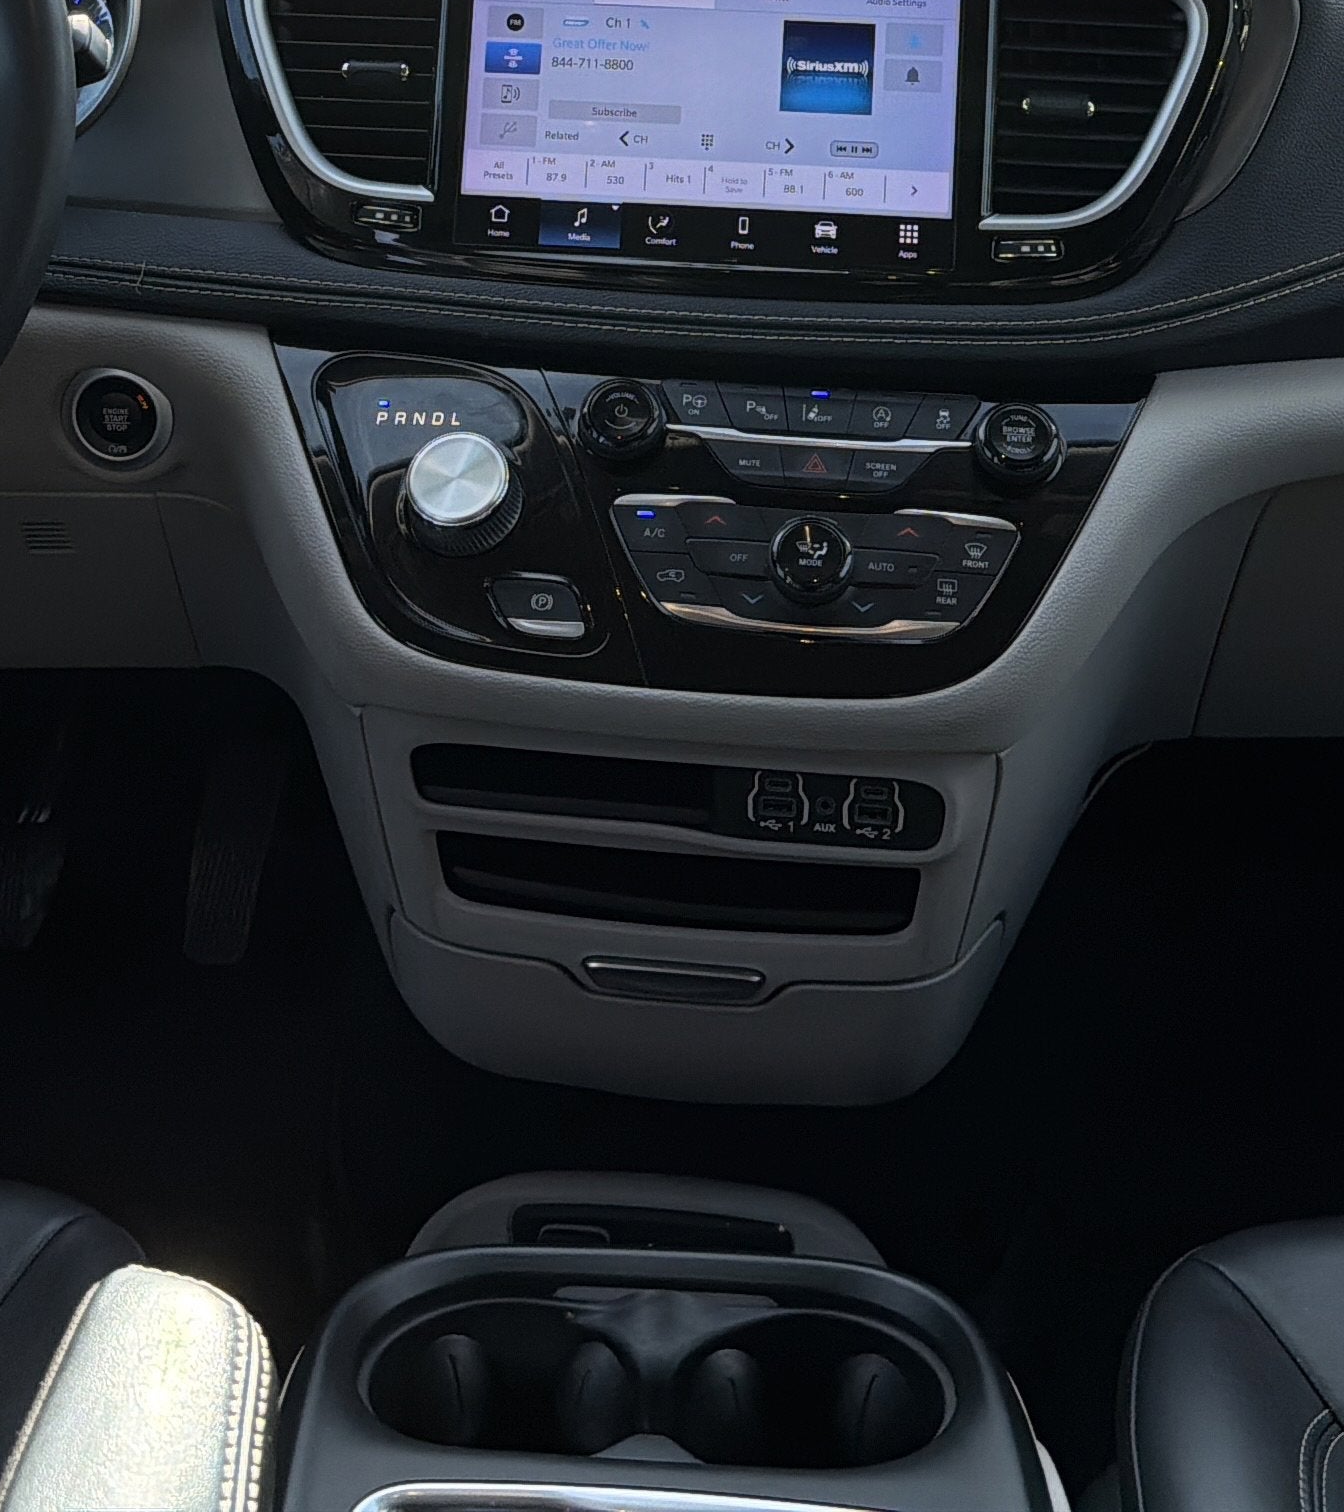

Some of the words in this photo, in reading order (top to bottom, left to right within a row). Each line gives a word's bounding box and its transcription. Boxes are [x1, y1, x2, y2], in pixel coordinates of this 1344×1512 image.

[605, 17, 622, 28] Ch
[626, 18, 631, 29] 1
[552, 38, 584, 49] Great
[587, 38, 618, 51] Offer
[551, 56, 634, 71] 844-711-8800
[592, 106, 638, 118] Subscribe
[545, 130, 579, 141] Related
[633, 135, 649, 144] CH
[765, 141, 781, 151] CH
[493, 161, 505, 169] All
[542, 157, 556, 165] FM
[601, 160, 616, 168] AM
[483, 170, 513, 180] Presets
[607, 175, 625, 185] 530
[666, 174, 685, 184] Hits
[721, 177, 740, 185] Hold
[845, 187, 864, 197] 600
[487, 229, 510, 238] Home
[567, 232, 591, 242] Media
[645, 236, 678, 246] Comfort
[730, 241, 755, 250] Phone
[810, 245, 839, 255] Vehicle
[898, 250, 918, 260] Apps
[688, 408, 700, 416] ON
[764, 413, 778, 421] OFF
[1002, 426, 1035, 434] BROWSE
[1006, 434, 1033, 443] ENTER
[739, 459, 761, 468] MUTE
[865, 462, 897, 471] SCREEN
[872, 470, 889, 478] OFF
[643, 527, 666, 538] A/C
[729, 554, 748, 562] OFF
[798, 559, 823, 567] MODE
[868, 561, 895, 572] AUTO
[962, 559, 989, 568] FRONT
[935, 596, 957, 605] REAR
[787, 821, 794, 833] 1
[813, 822, 836, 833] AUX
[881, 828, 891, 840] 2
